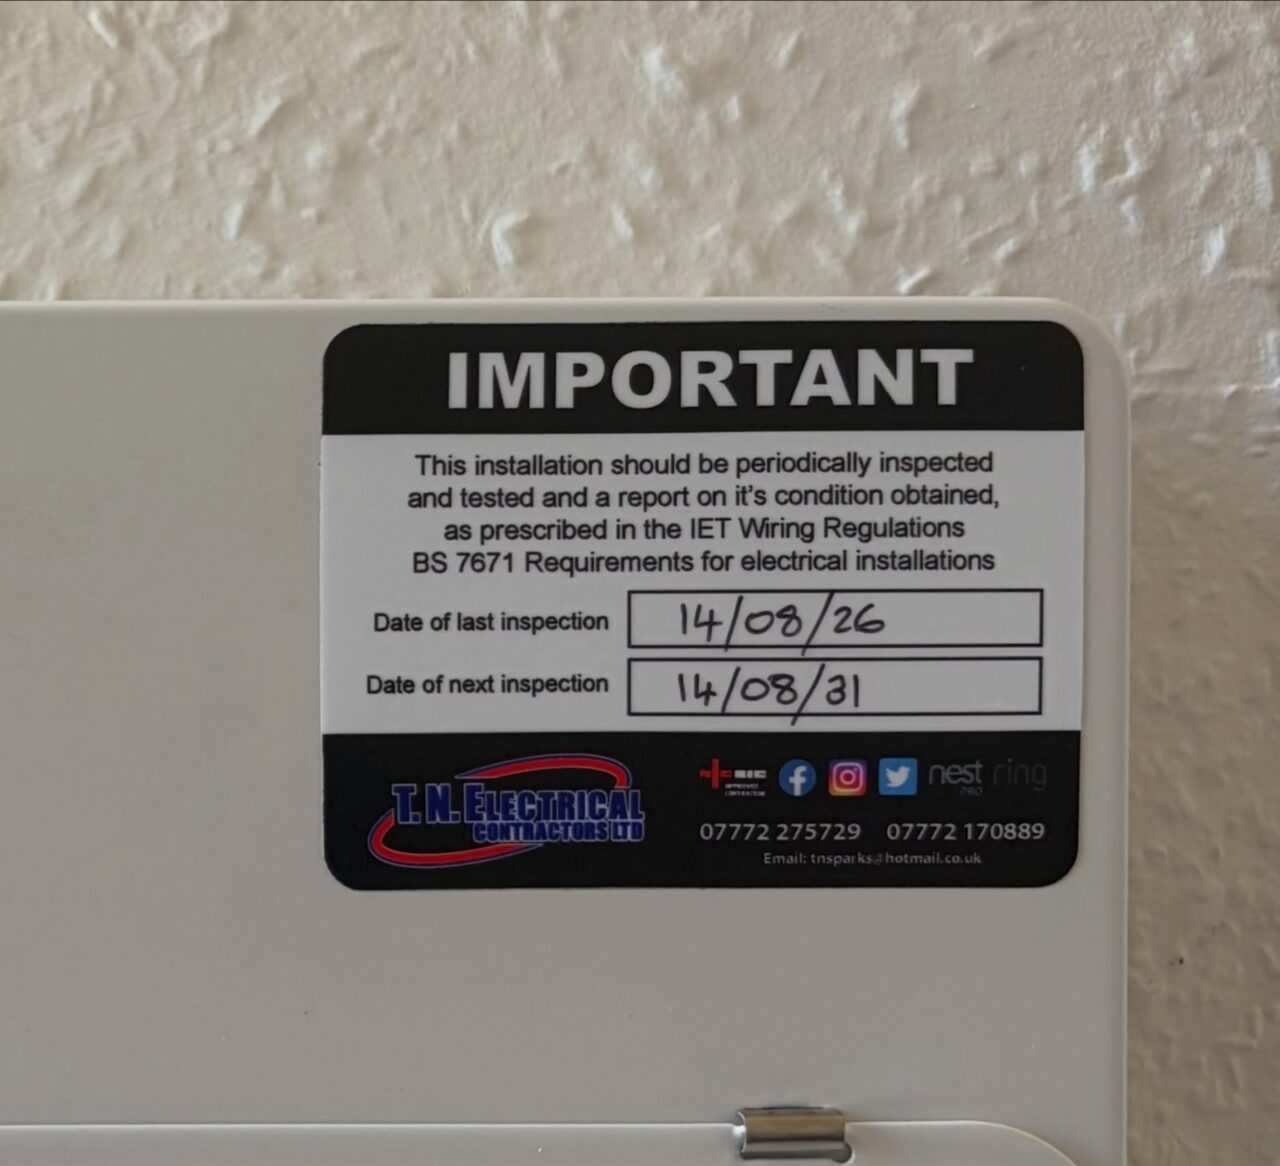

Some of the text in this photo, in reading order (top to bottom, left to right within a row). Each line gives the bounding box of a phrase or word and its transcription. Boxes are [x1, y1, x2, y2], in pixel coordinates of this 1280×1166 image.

[448, 348, 974, 409] IMPORTANT
[415, 451, 993, 480] This installation should be periodically inspected
[408, 487, 452, 509] and
[460, 487, 534, 509] tested
[542, 486, 587, 508] and
[595, 490, 610, 508] a
[619, 488, 689, 513] report
[697, 489, 726, 507] on
[775, 484, 883, 506] condition
[891, 483, 999, 509] obtained,
[444, 516, 965, 546] as prescribed in the IET Wiring Regulations
[413, 548, 995, 578] BS 7671 Requirements for electrical installations
[374, 611, 609, 636] Date of last inspection
[680, 592, 886, 656] 14/08/26
[367, 673, 609, 698] Date of next inspection
[678, 663, 860, 726] 14/08/31
[928, 760, 984, 785] nest
[993, 758, 1048, 792] ring
[391, 782, 421, 825] T.
[425, 782, 461, 824] N.
[473, 820, 644, 843] CONTRACTORS LTD
[699, 822, 861, 841] 07772 275729
[886, 822, 1046, 841] 07772 170889
[763, 851, 983, 868] Email: tnsparks@hotmail.co.uk
